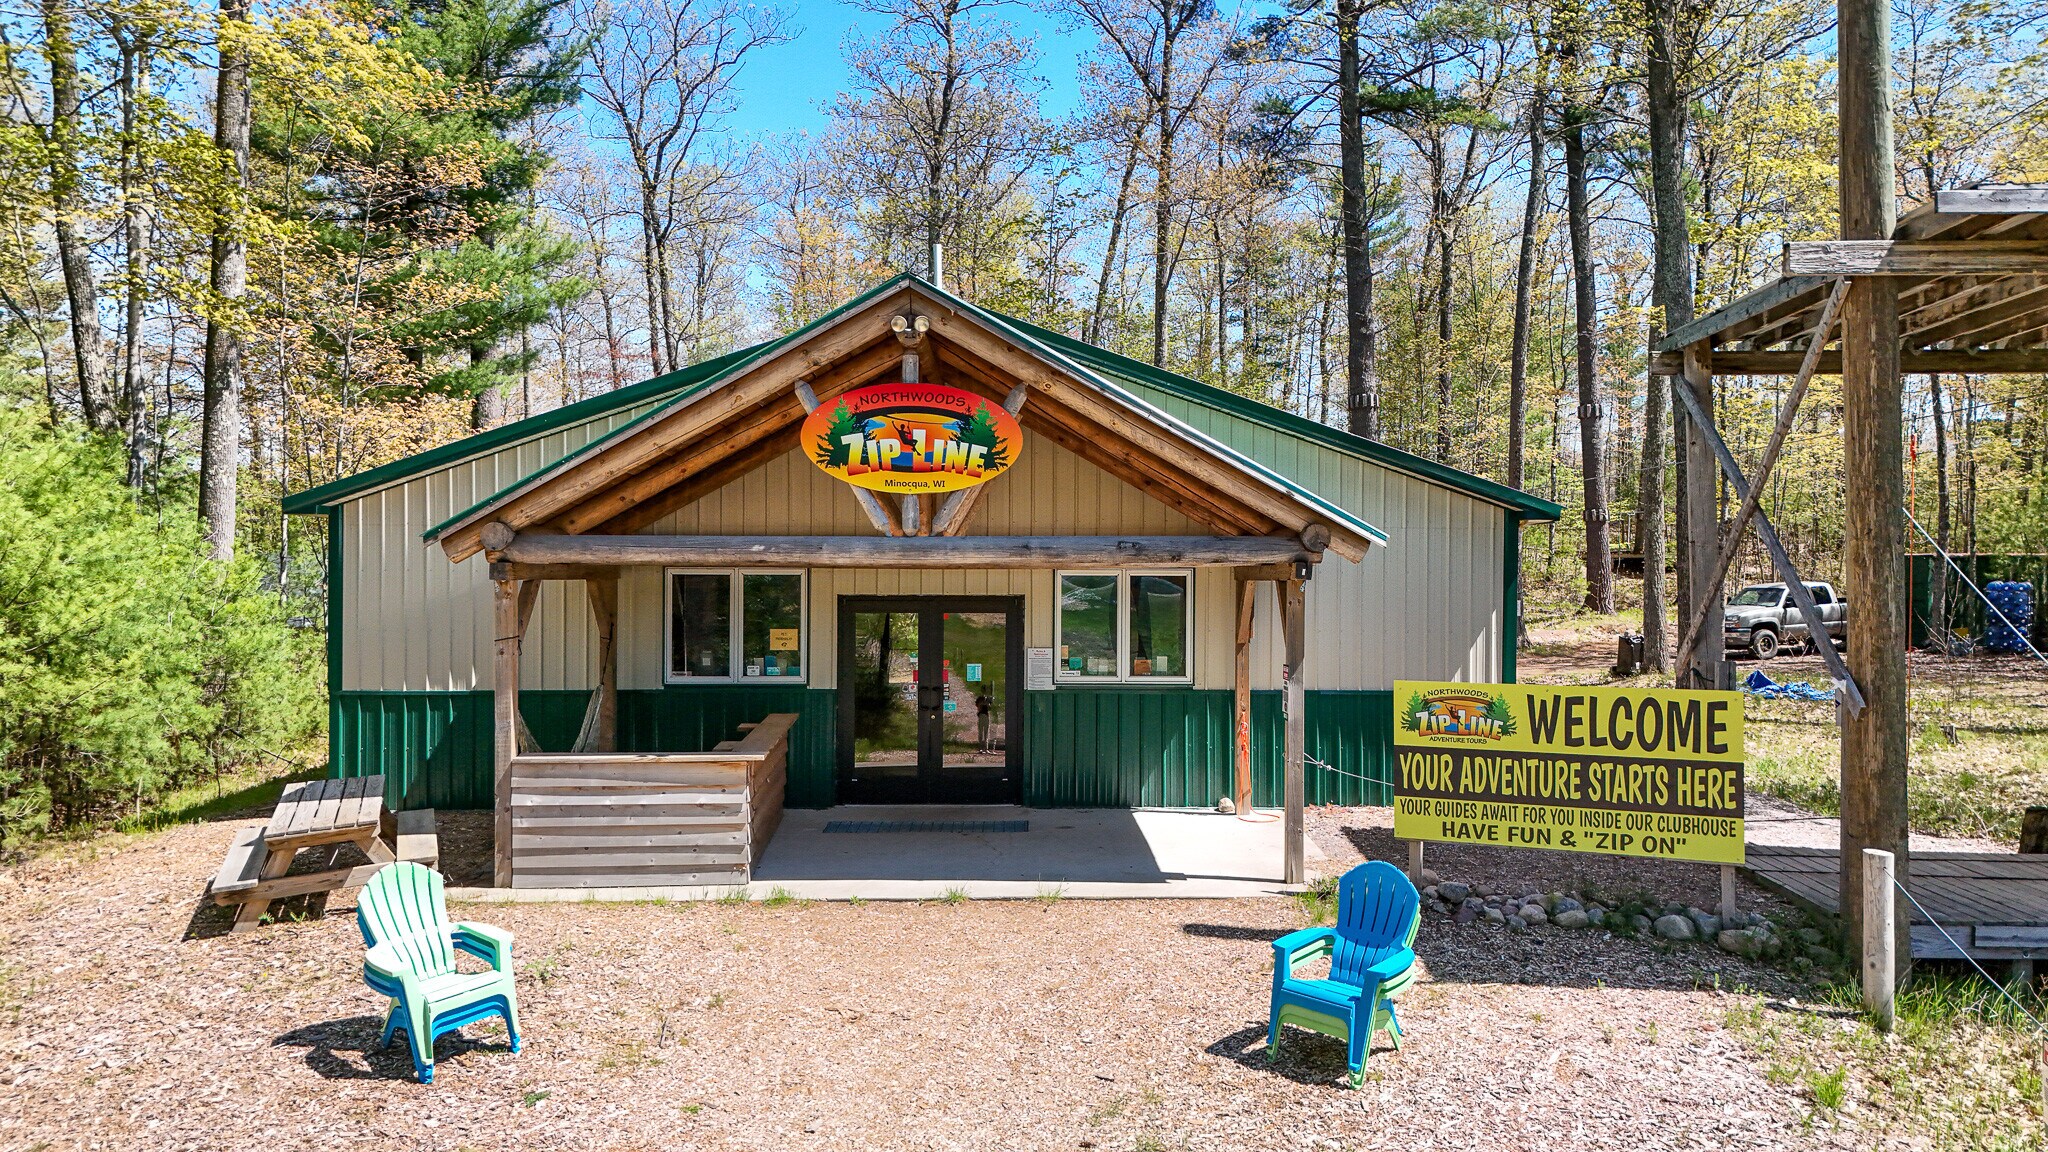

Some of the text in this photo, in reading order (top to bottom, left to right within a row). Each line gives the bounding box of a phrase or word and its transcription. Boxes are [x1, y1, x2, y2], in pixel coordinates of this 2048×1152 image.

[859, 391, 966, 407] NORTHWOODS
[841, 428, 988, 479] ZIP LINE
[884, 479, 946, 489] Minocqua, WI
[1427, 688, 1489, 698] NORTHWOODS
[1415, 709, 1504, 741] ZIP LINE
[1527, 694, 1729, 754] WELCOME
[1400, 752, 1737, 810] YOUR ADVENTURE STARTS HERE
[1400, 798, 1736, 837] YOUR GUIDES AWAIT FOR YOU INSIDE OUR CLUBHOUSE
[1442, 821, 1687, 854] HAVE FUN & "ZIP ON"
